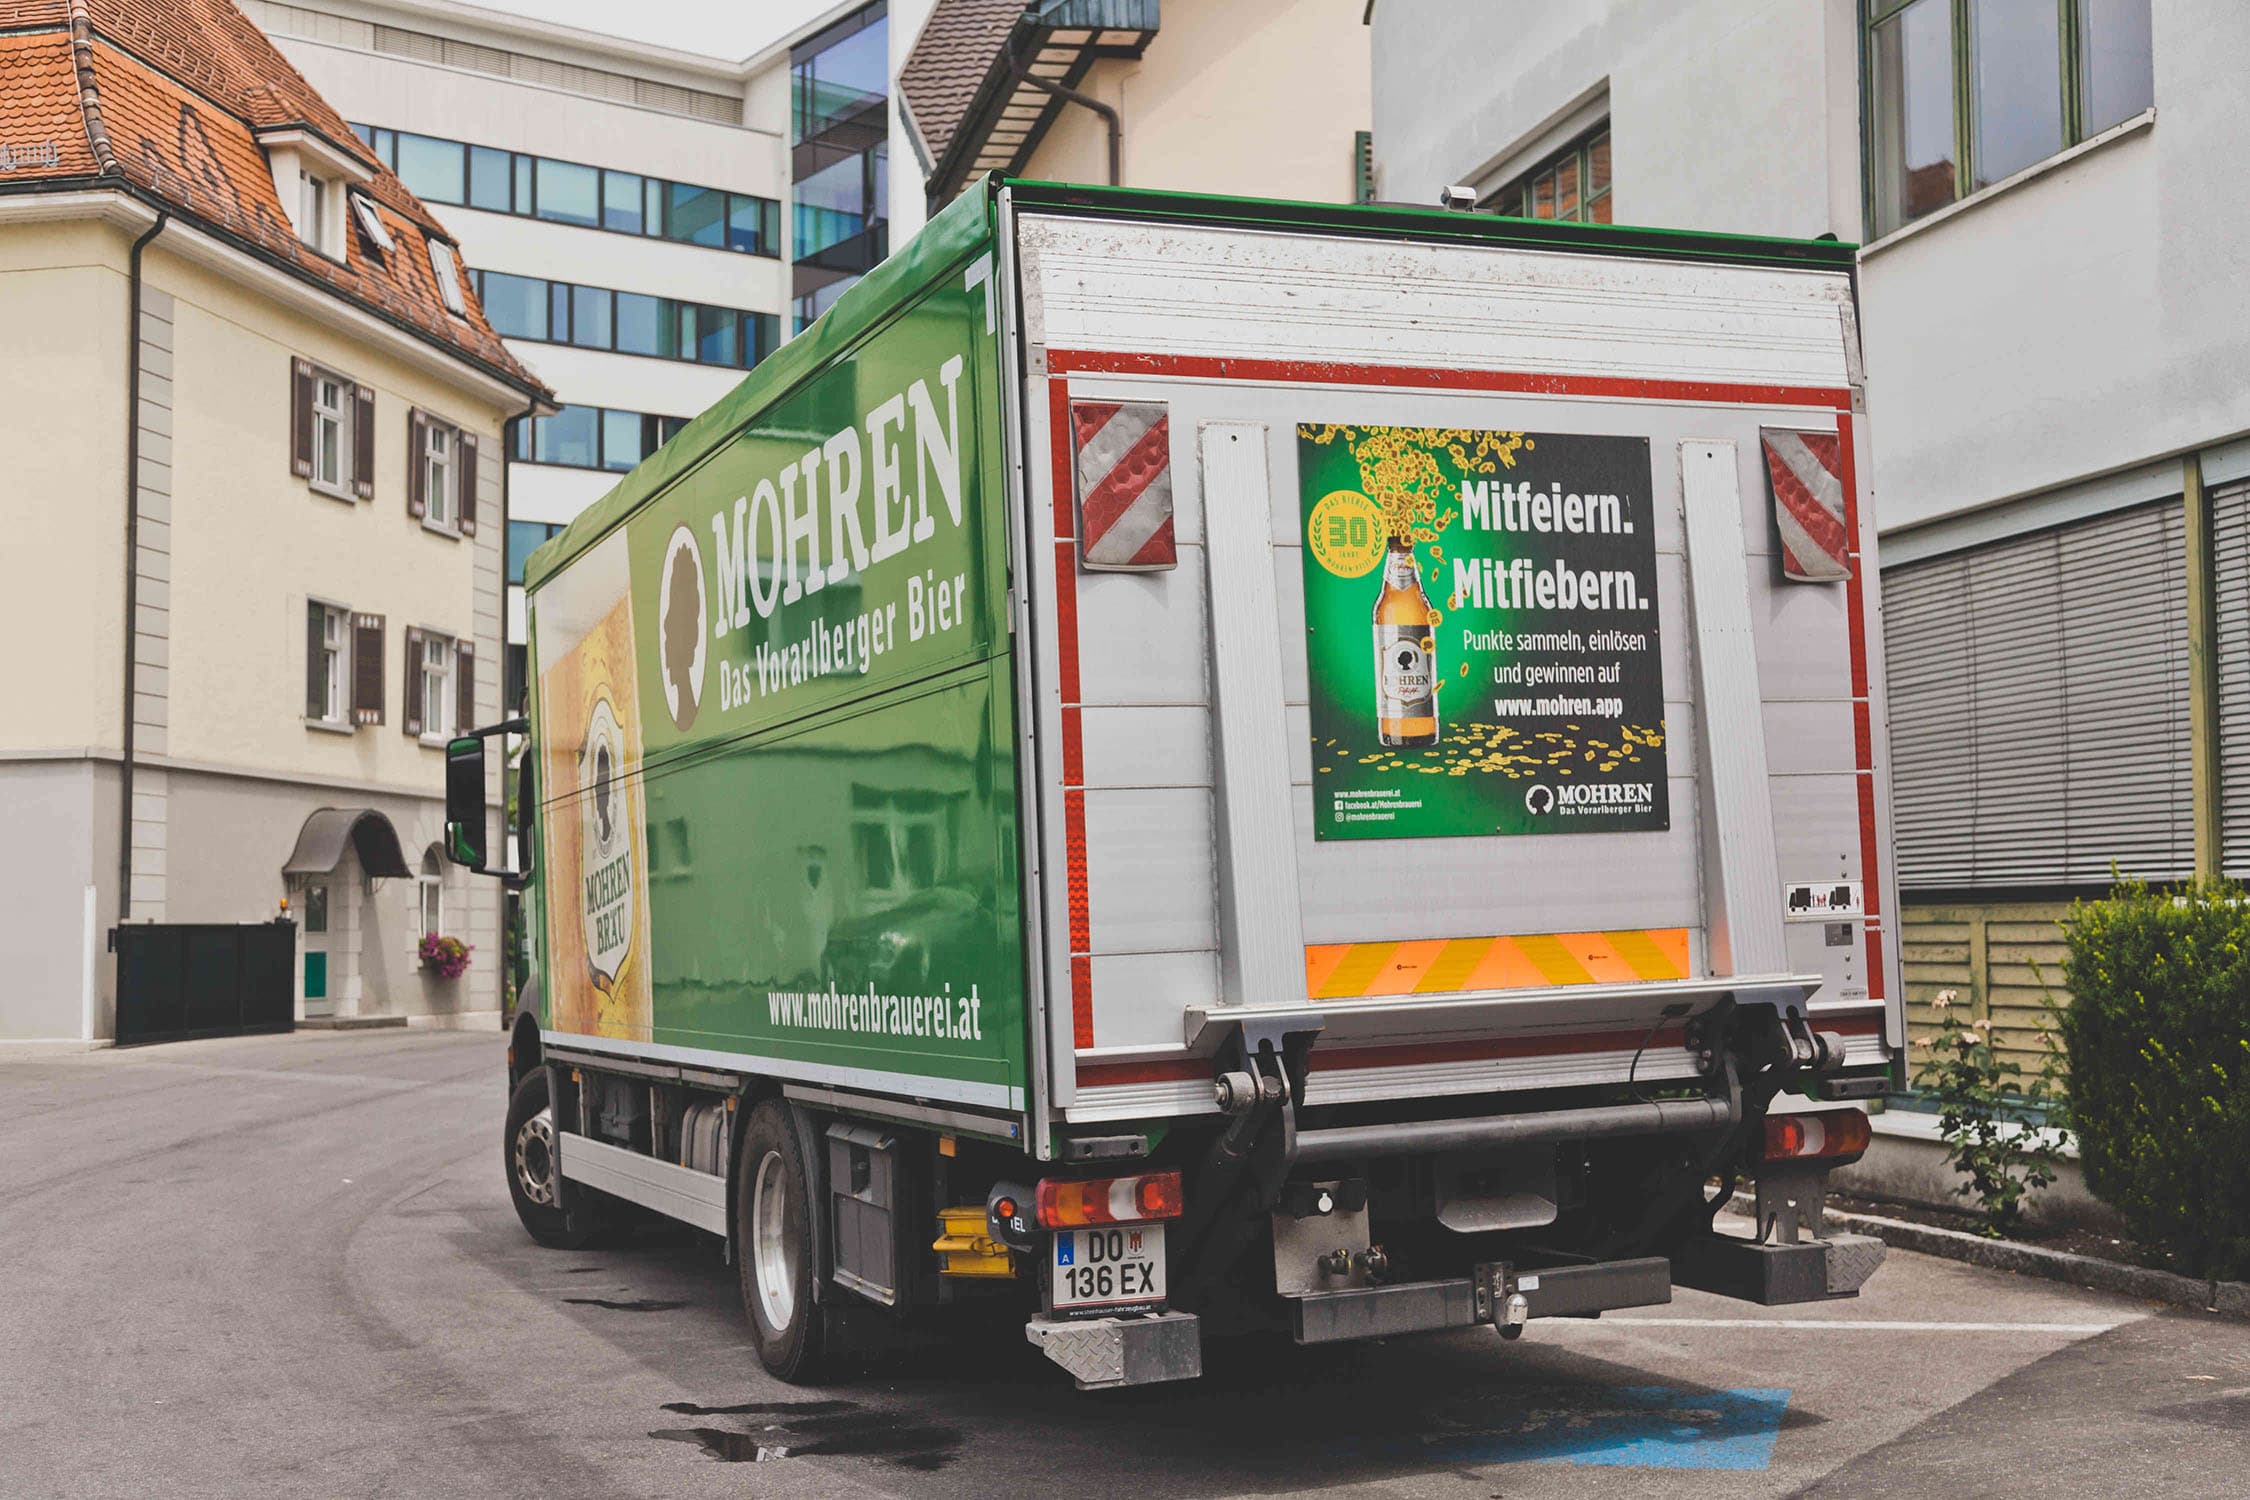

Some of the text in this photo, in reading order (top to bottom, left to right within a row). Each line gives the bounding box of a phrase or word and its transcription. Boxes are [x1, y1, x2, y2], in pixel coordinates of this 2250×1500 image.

[712, 354, 963, 639] MOHREN
[1461, 480, 1634, 534] Mitfeiern.
[1328, 515, 1368, 547] 30
[1453, 558, 1648, 610] Mitfiebern.
[720, 569, 966, 712] Das Vorarlberger Bier
[1463, 629, 1646, 654] Punkte sammeln, einlösen
[1384, 675, 1429, 685] HREN
[1494, 661, 1621, 687] und gewinnen auf
[1495, 694, 1624, 719] www.mohren.app
[1556, 783, 1653, 805] MOHREN
[1560, 803, 1653, 816] Das Vorarlberger Bier
[586, 850, 630, 916] MOHREN
[768, 981, 982, 1041] www.mohrenbrauerei.at
[1062, 1254, 1070, 1264] A
[1088, 1230, 1123, 1263] DO
[1065, 1262, 1154, 1298] 136 EX
